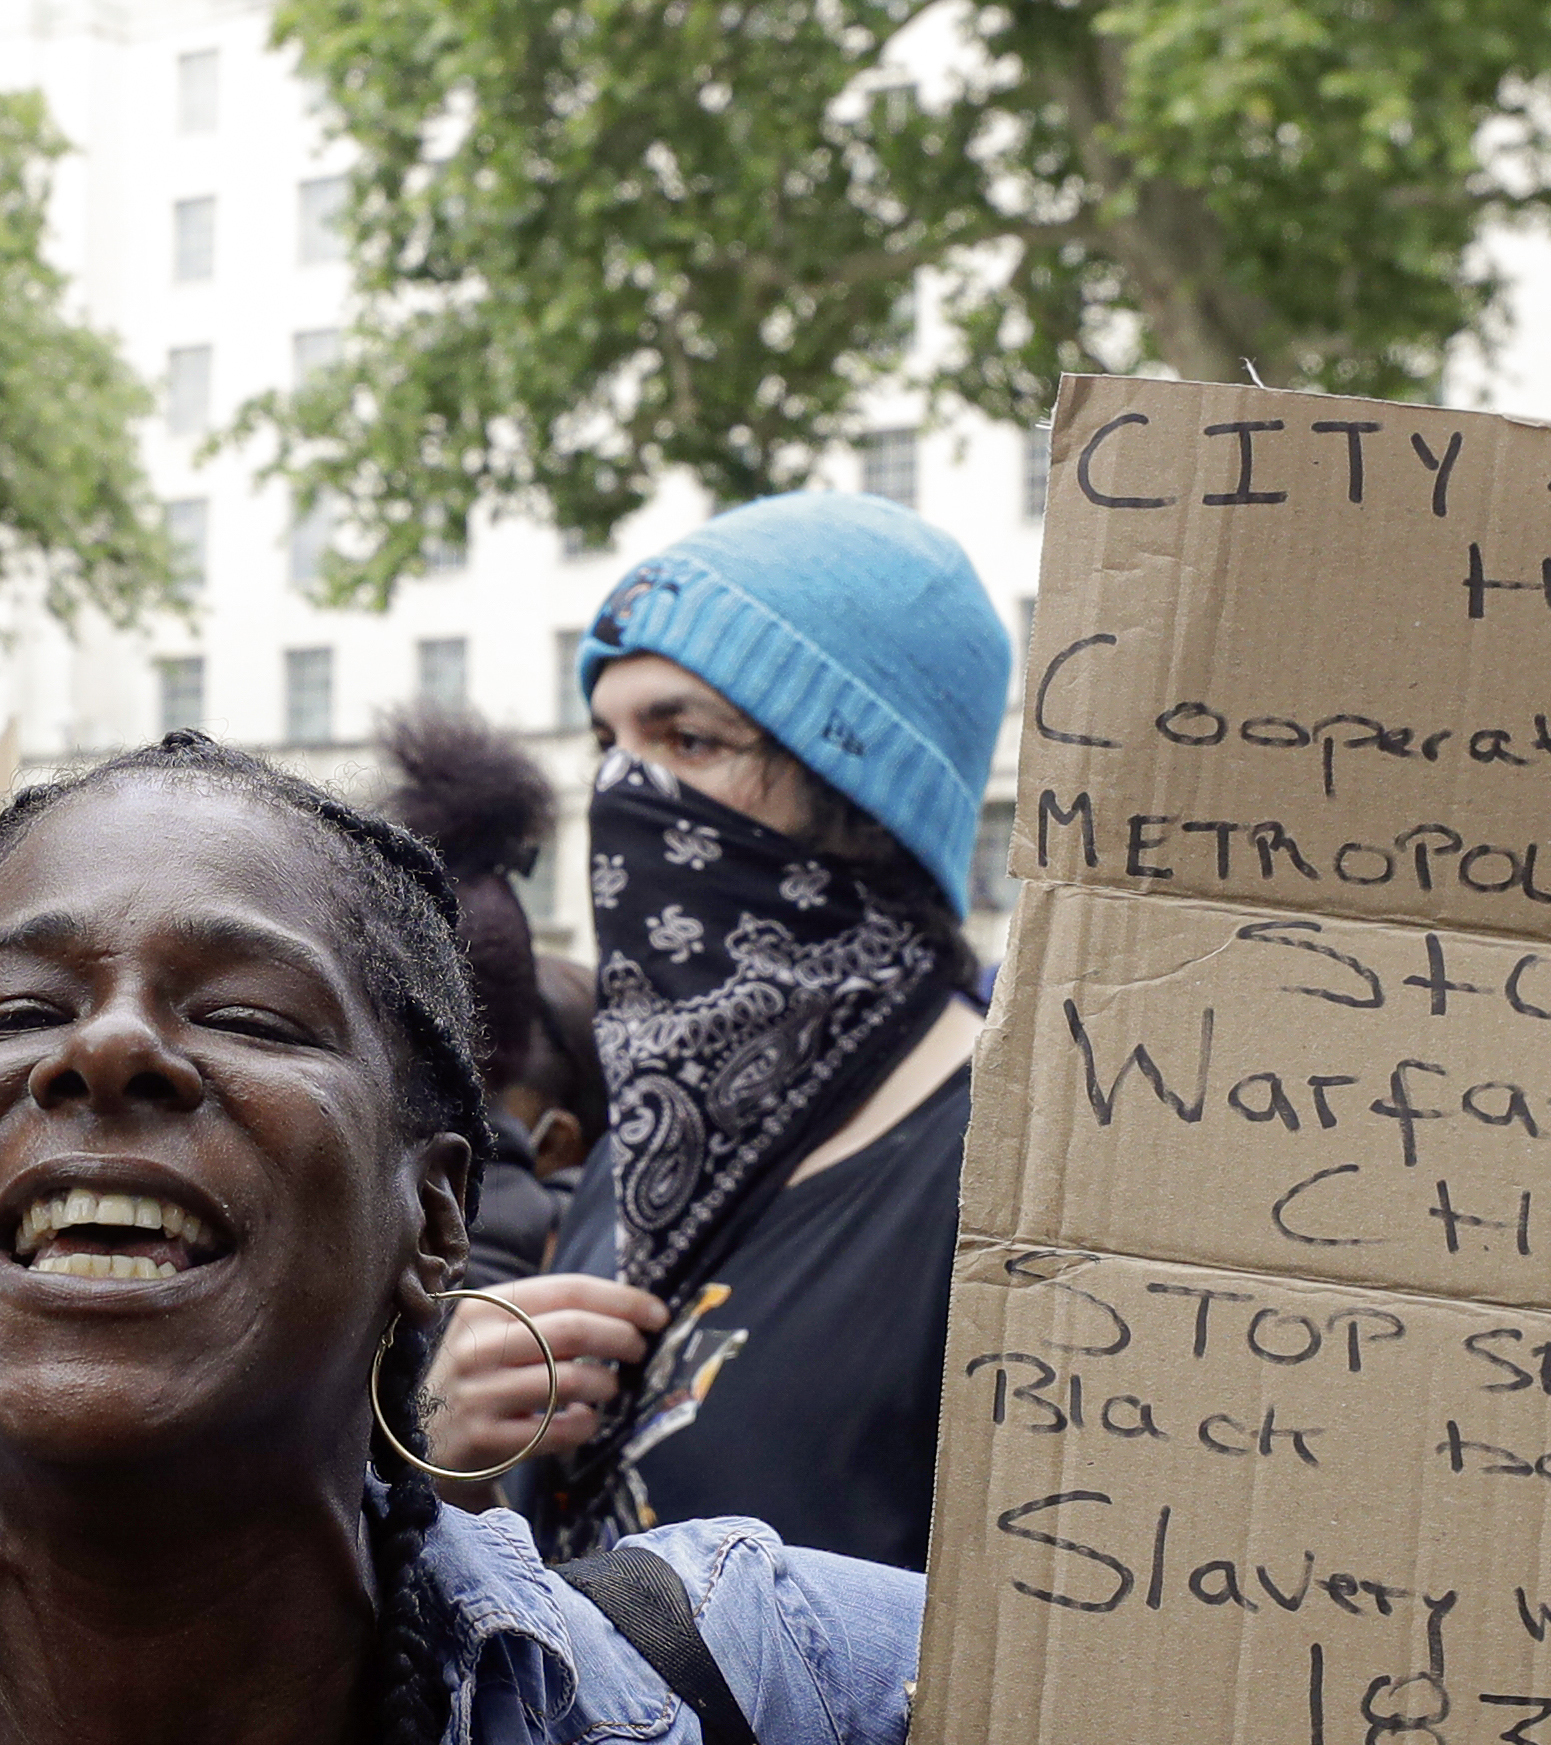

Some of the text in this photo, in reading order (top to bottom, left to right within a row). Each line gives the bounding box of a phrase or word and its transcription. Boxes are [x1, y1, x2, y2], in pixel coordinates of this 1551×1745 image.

[1077, 414, 1462, 517] CITY
[1065, 999, 1539, 1166] Warfa
[1005, 1249, 1405, 1372] STOP
[966, 1353, 1324, 1466] Black
[997, 1490, 1458, 1680] Slavery
